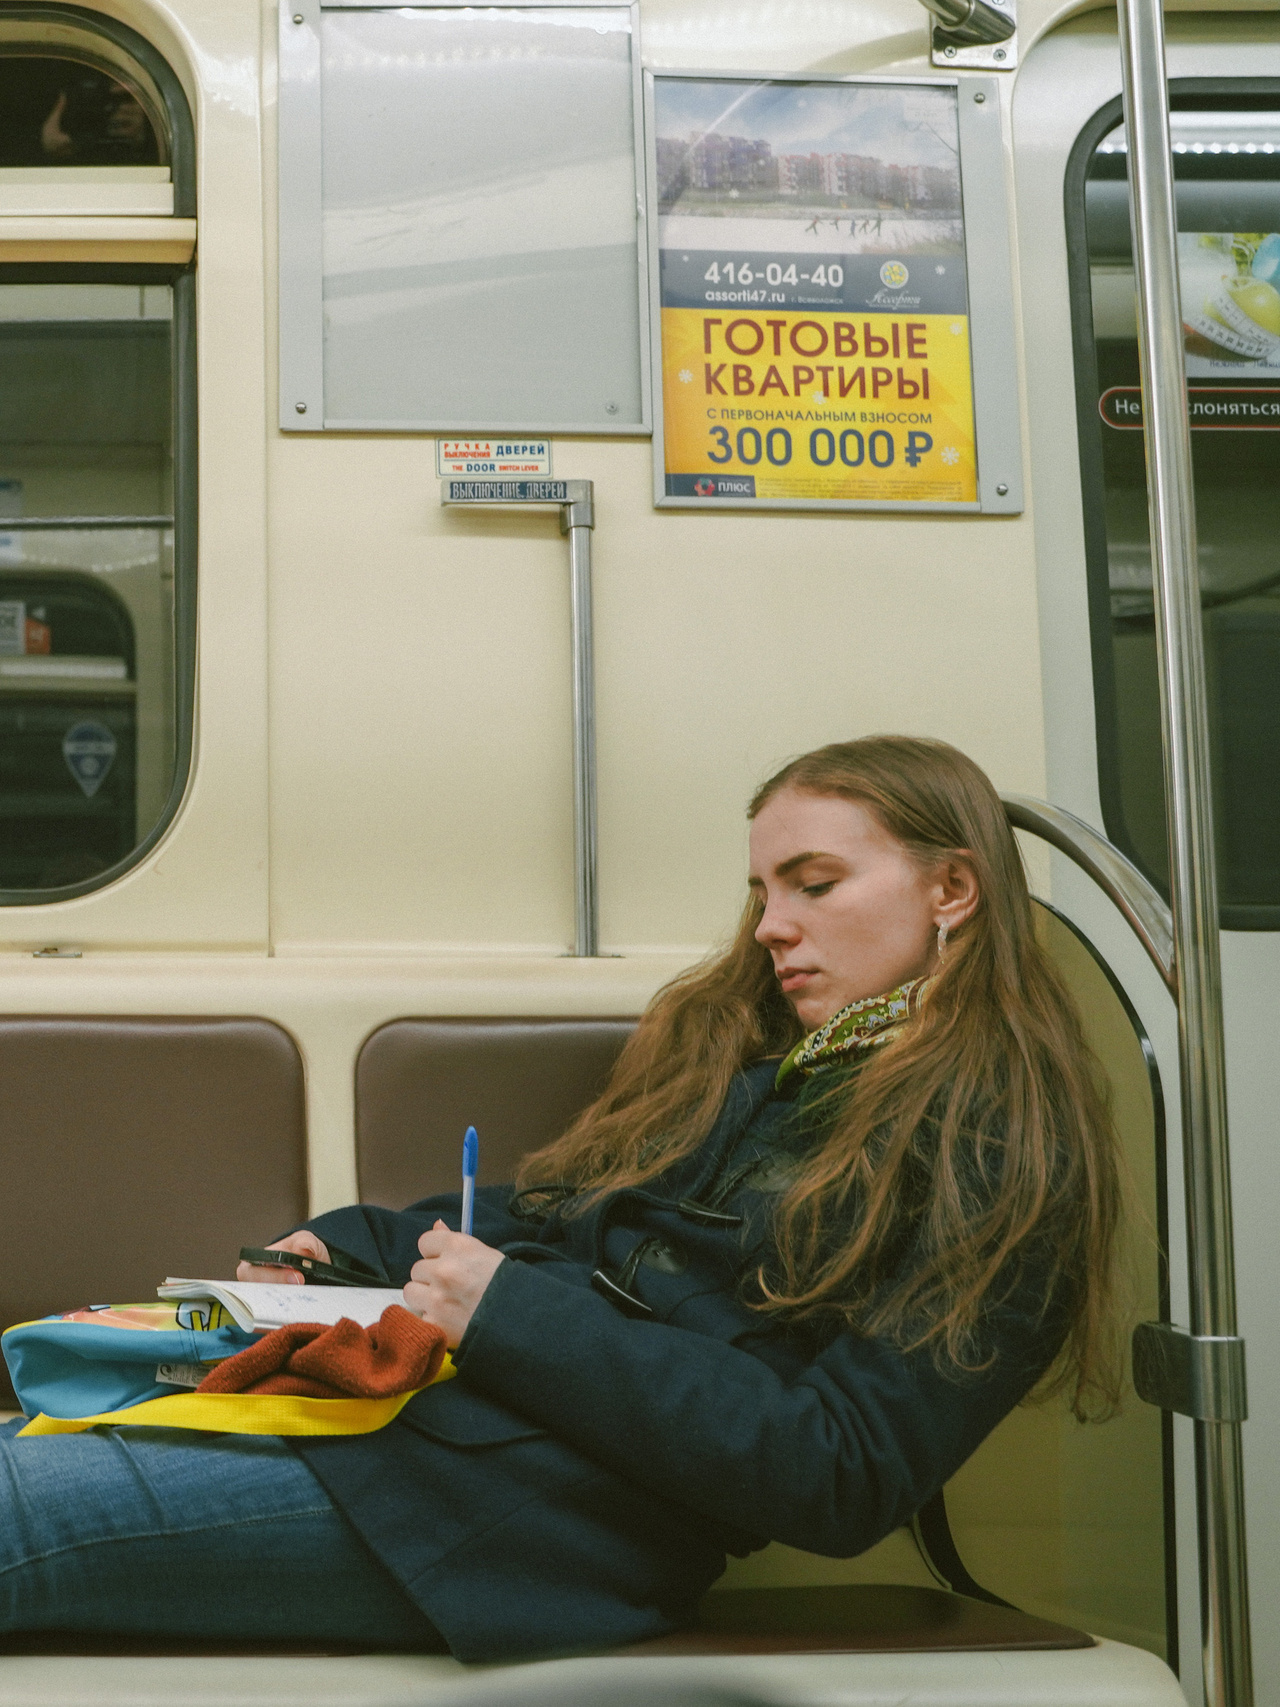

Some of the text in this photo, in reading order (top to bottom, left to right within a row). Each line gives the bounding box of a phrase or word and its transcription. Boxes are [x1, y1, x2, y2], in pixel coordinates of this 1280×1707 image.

[704, 261, 844, 288] 416-04-40
[704, 289, 786, 304] assorti47.ru
[703, 317, 928, 360] ГОТОВЫЕ
[704, 362, 930, 400] КВАРТИРЫ
[1115, 399, 1140, 415] Не
[706, 408, 933, 425] С ПЕРВОНАЧАЛЬНЫМ ВЗНОСОМ
[444, 443, 545, 458] ВЫКЛЮЧЕНИЯ ДВЕРЕЙ
[707, 425, 793, 467] 300
[809, 427, 895, 468] 000
[466, 463, 496, 472] DOOR
[452, 481, 565, 499] ВЫКЛЮЧЕНИЕ ДВЕРЕЙ
[717, 480, 751, 494] ПЛЮС
